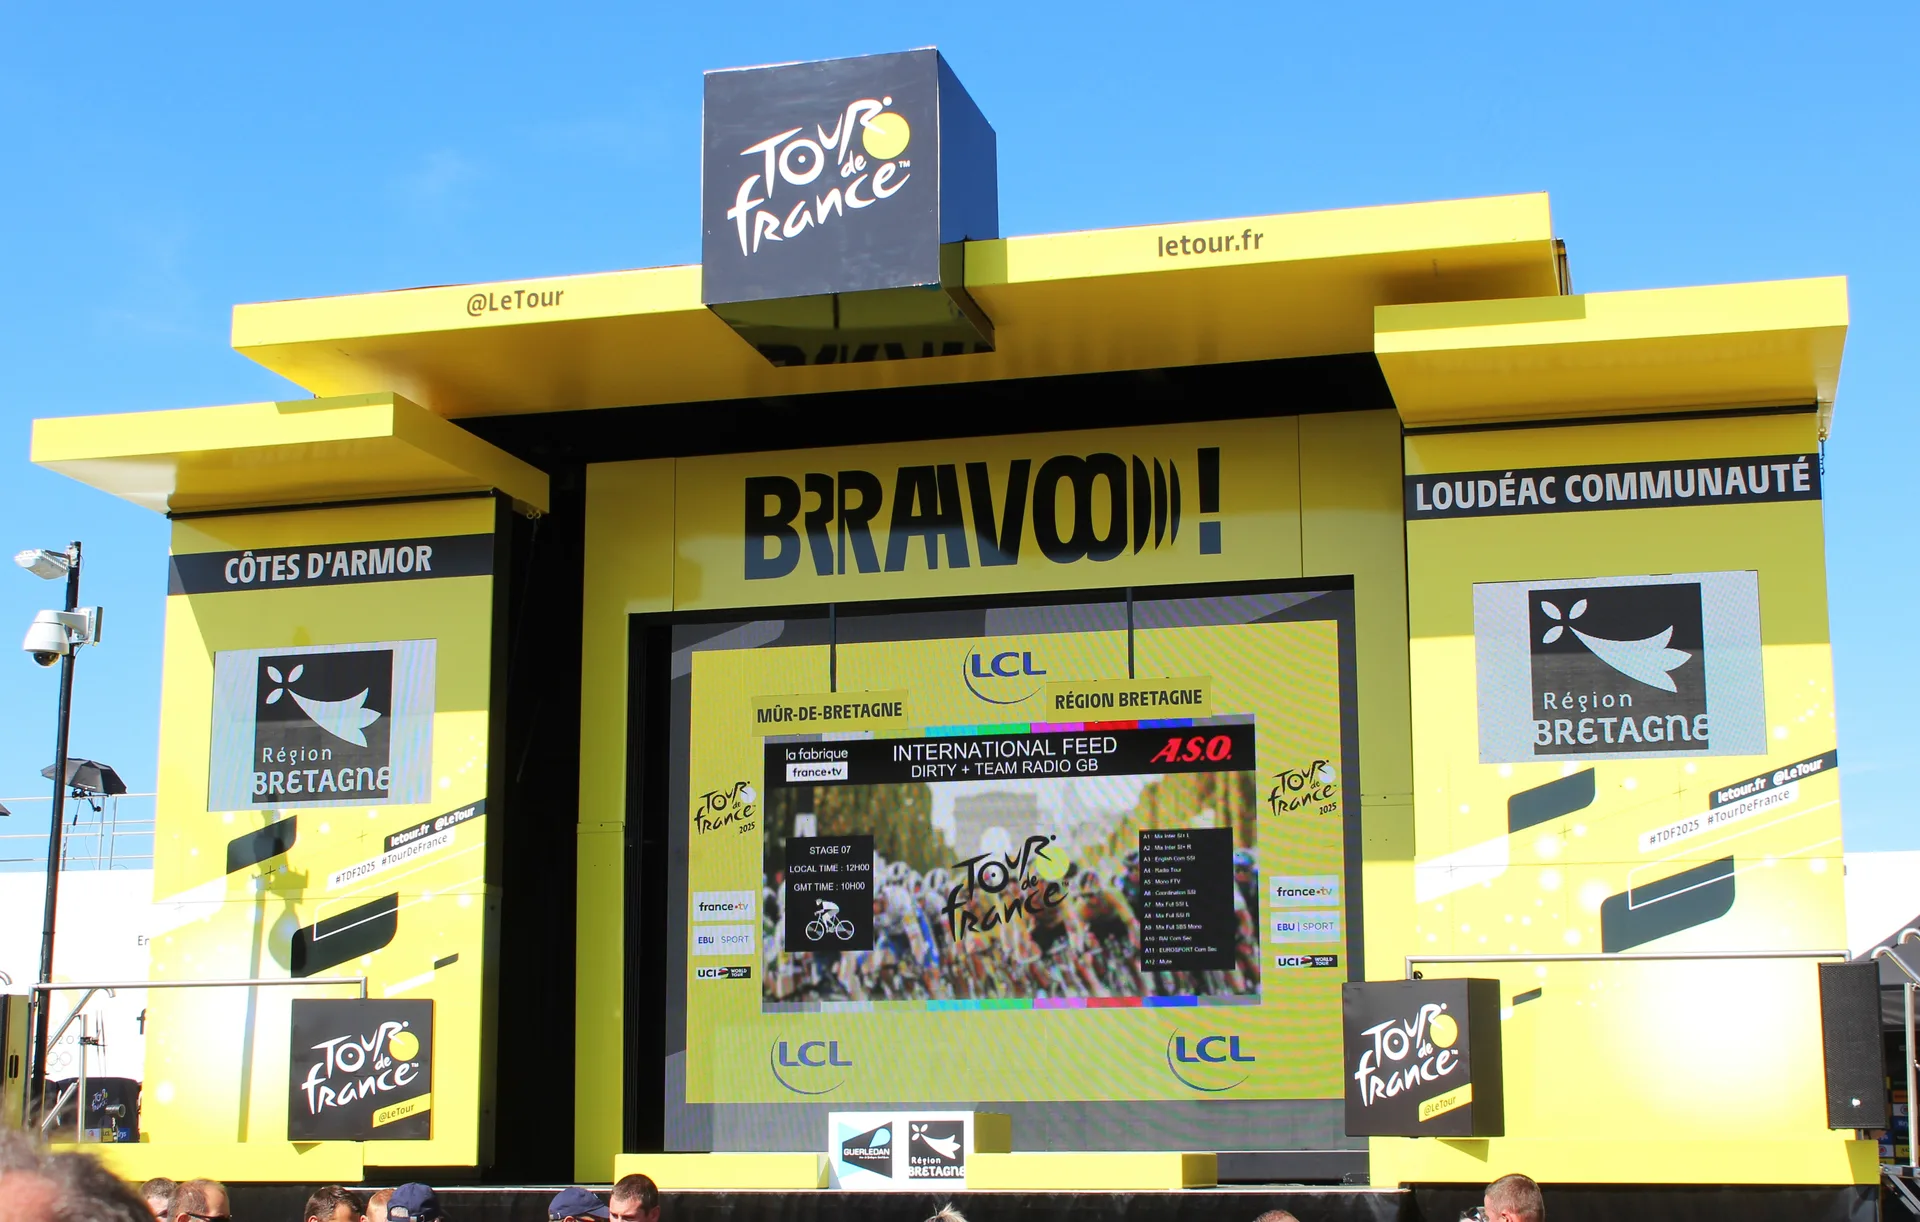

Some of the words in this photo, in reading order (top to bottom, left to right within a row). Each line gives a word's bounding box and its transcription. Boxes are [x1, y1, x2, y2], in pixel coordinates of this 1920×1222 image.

[741, 96, 892, 198] TOUR
[841, 151, 867, 177] de
[1158, 229, 1264, 257] letour.fr
[467, 290, 564, 317] @LeTour
[1416, 472, 1556, 511] LOUDÉAC
[1565, 456, 1811, 503] COMMUNAUTÉ
[225, 551, 300, 584] CÔTES
[307, 545, 433, 579] D'ARMOR
[971, 651, 1047, 678] LCL
[1055, 691, 1114, 710] RÉGION
[1119, 689, 1202, 708] BRETAGNE
[1543, 691, 1633, 713] Région
[757, 702, 903, 724] MÛR-DE-BRETAGNE
[1533, 714, 1709, 746] BRETAGNE
[262, 746, 332, 766] Région
[786, 748, 796, 760] la
[798, 748, 849, 762] fabrique
[893, 739, 1056, 762] INTERNATIONAL
[1062, 736, 1117, 755] FEED
[1150, 735, 1232, 764] A.S.O.
[911, 764, 956, 778] DIRTY
[975, 762, 1017, 776] TEAM
[1022, 760, 1071, 774] RADIO
[1076, 758, 1099, 772] GB
[1272, 759, 1329, 794] TOUR
[253, 766, 389, 796] BRETAGNE
[1310, 781, 1320, 789] de
[1718, 778, 1766, 804] letour.fr
[1773, 758, 1823, 786] @LeTour
[699, 781, 750, 814] TOUR
[732, 801, 741, 809] de
[1319, 802, 1337, 815] 2025
[391, 822, 430, 847] letour.fr
[434, 806, 475, 831] @LeTour
[739, 821, 755, 835] 2025
[1649, 819, 1700, 845] #TDF2025
[1707, 789, 1790, 825] #TourDeFrance
[335, 862, 376, 885] #TDF2025
[382, 834, 448, 866] #TourDeFrance
[809, 846, 839, 855] STAGE
[841, 845, 851, 854] 07
[789, 865, 817, 873] LOCAL
[820, 864, 838, 872] TIME
[846, 863, 870, 872] 12H00
[952, 835, 1056, 902] TOUR
[793, 882, 812, 892] GMT
[814, 882, 834, 891] TIME
[841, 881, 865, 891] 10H00
[1021, 872, 1037, 890] de
[1277, 923, 1295, 931] EBU
[1303, 922, 1334, 931] SPORT
[698, 936, 714, 944] EBU
[721, 935, 749, 944] SPORT
[698, 969, 716, 977] UCI
[1278, 958, 1299, 966] UCI
[1361, 1003, 1447, 1067] TOUR
[311, 1021, 409, 1079] TOUR
[779, 1041, 852, 1067] LCL
[1176, 1036, 1255, 1062] LCL
[1418, 1039, 1433, 1058] de
[375, 1053, 391, 1070] de
[378, 1104, 415, 1122] @LeTour
[1424, 1096, 1456, 1116] @LeTour
[908, 1166, 965, 1177] BRETAGNE
[911, 1156, 941, 1166] Région
